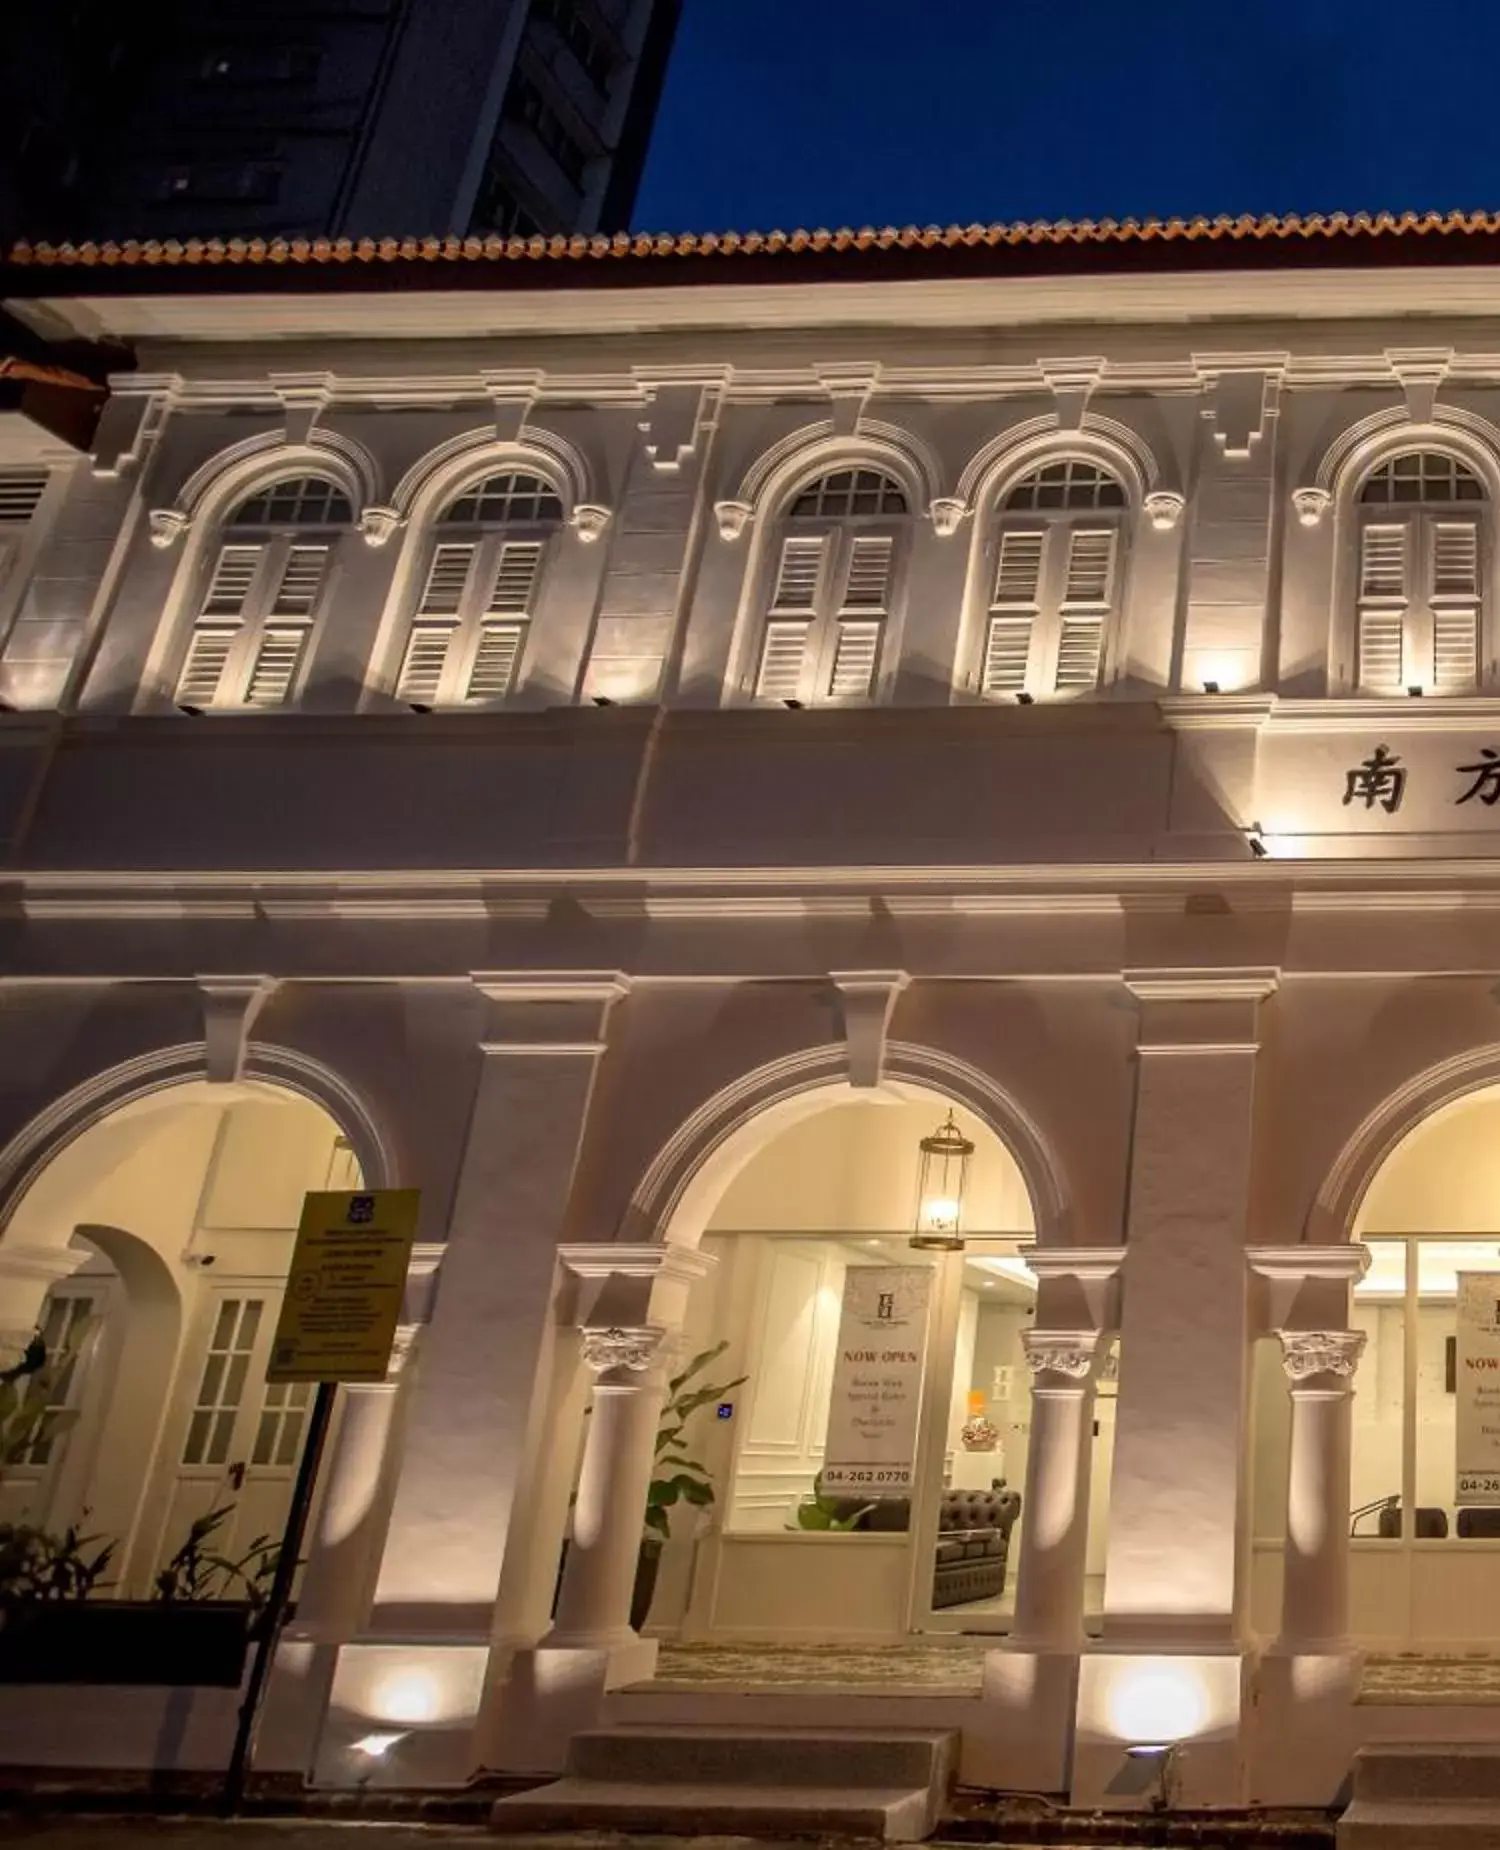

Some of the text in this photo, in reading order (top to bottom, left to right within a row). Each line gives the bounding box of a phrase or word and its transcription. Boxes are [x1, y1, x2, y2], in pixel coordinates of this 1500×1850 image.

[843, 1350, 918, 1363] NOW OPEN
[1465, 1358, 1498, 1370] NOW
